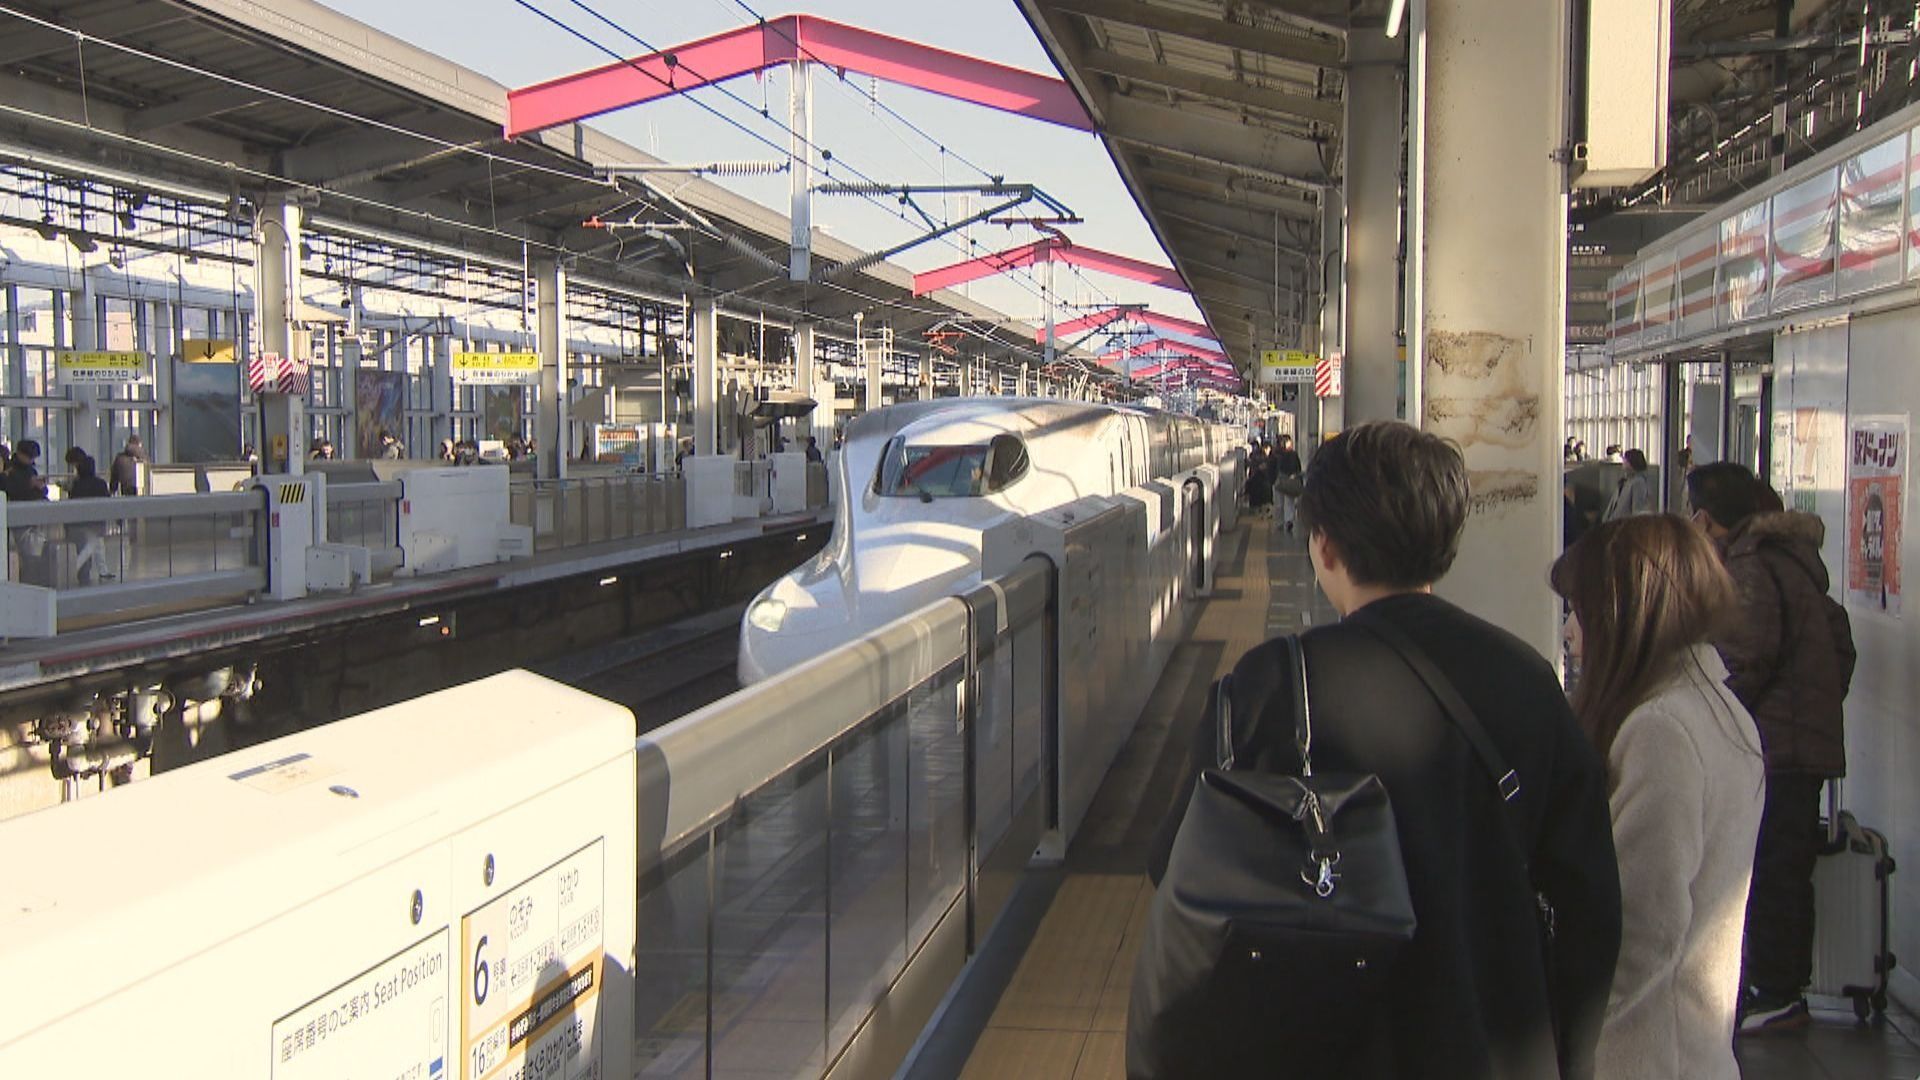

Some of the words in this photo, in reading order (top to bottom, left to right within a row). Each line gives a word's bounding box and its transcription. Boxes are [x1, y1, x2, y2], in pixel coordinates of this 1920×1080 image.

[560, 866, 578, 895] ひかり
[510, 896, 532, 925] のぞみ
[474, 935, 489, 1006] 6
[281, 990, 370, 1063] 座席番号のご案内
[374, 974, 398, 1009] Seat
[401, 952, 442, 993] Position
[472, 1042, 486, 1079] 16
